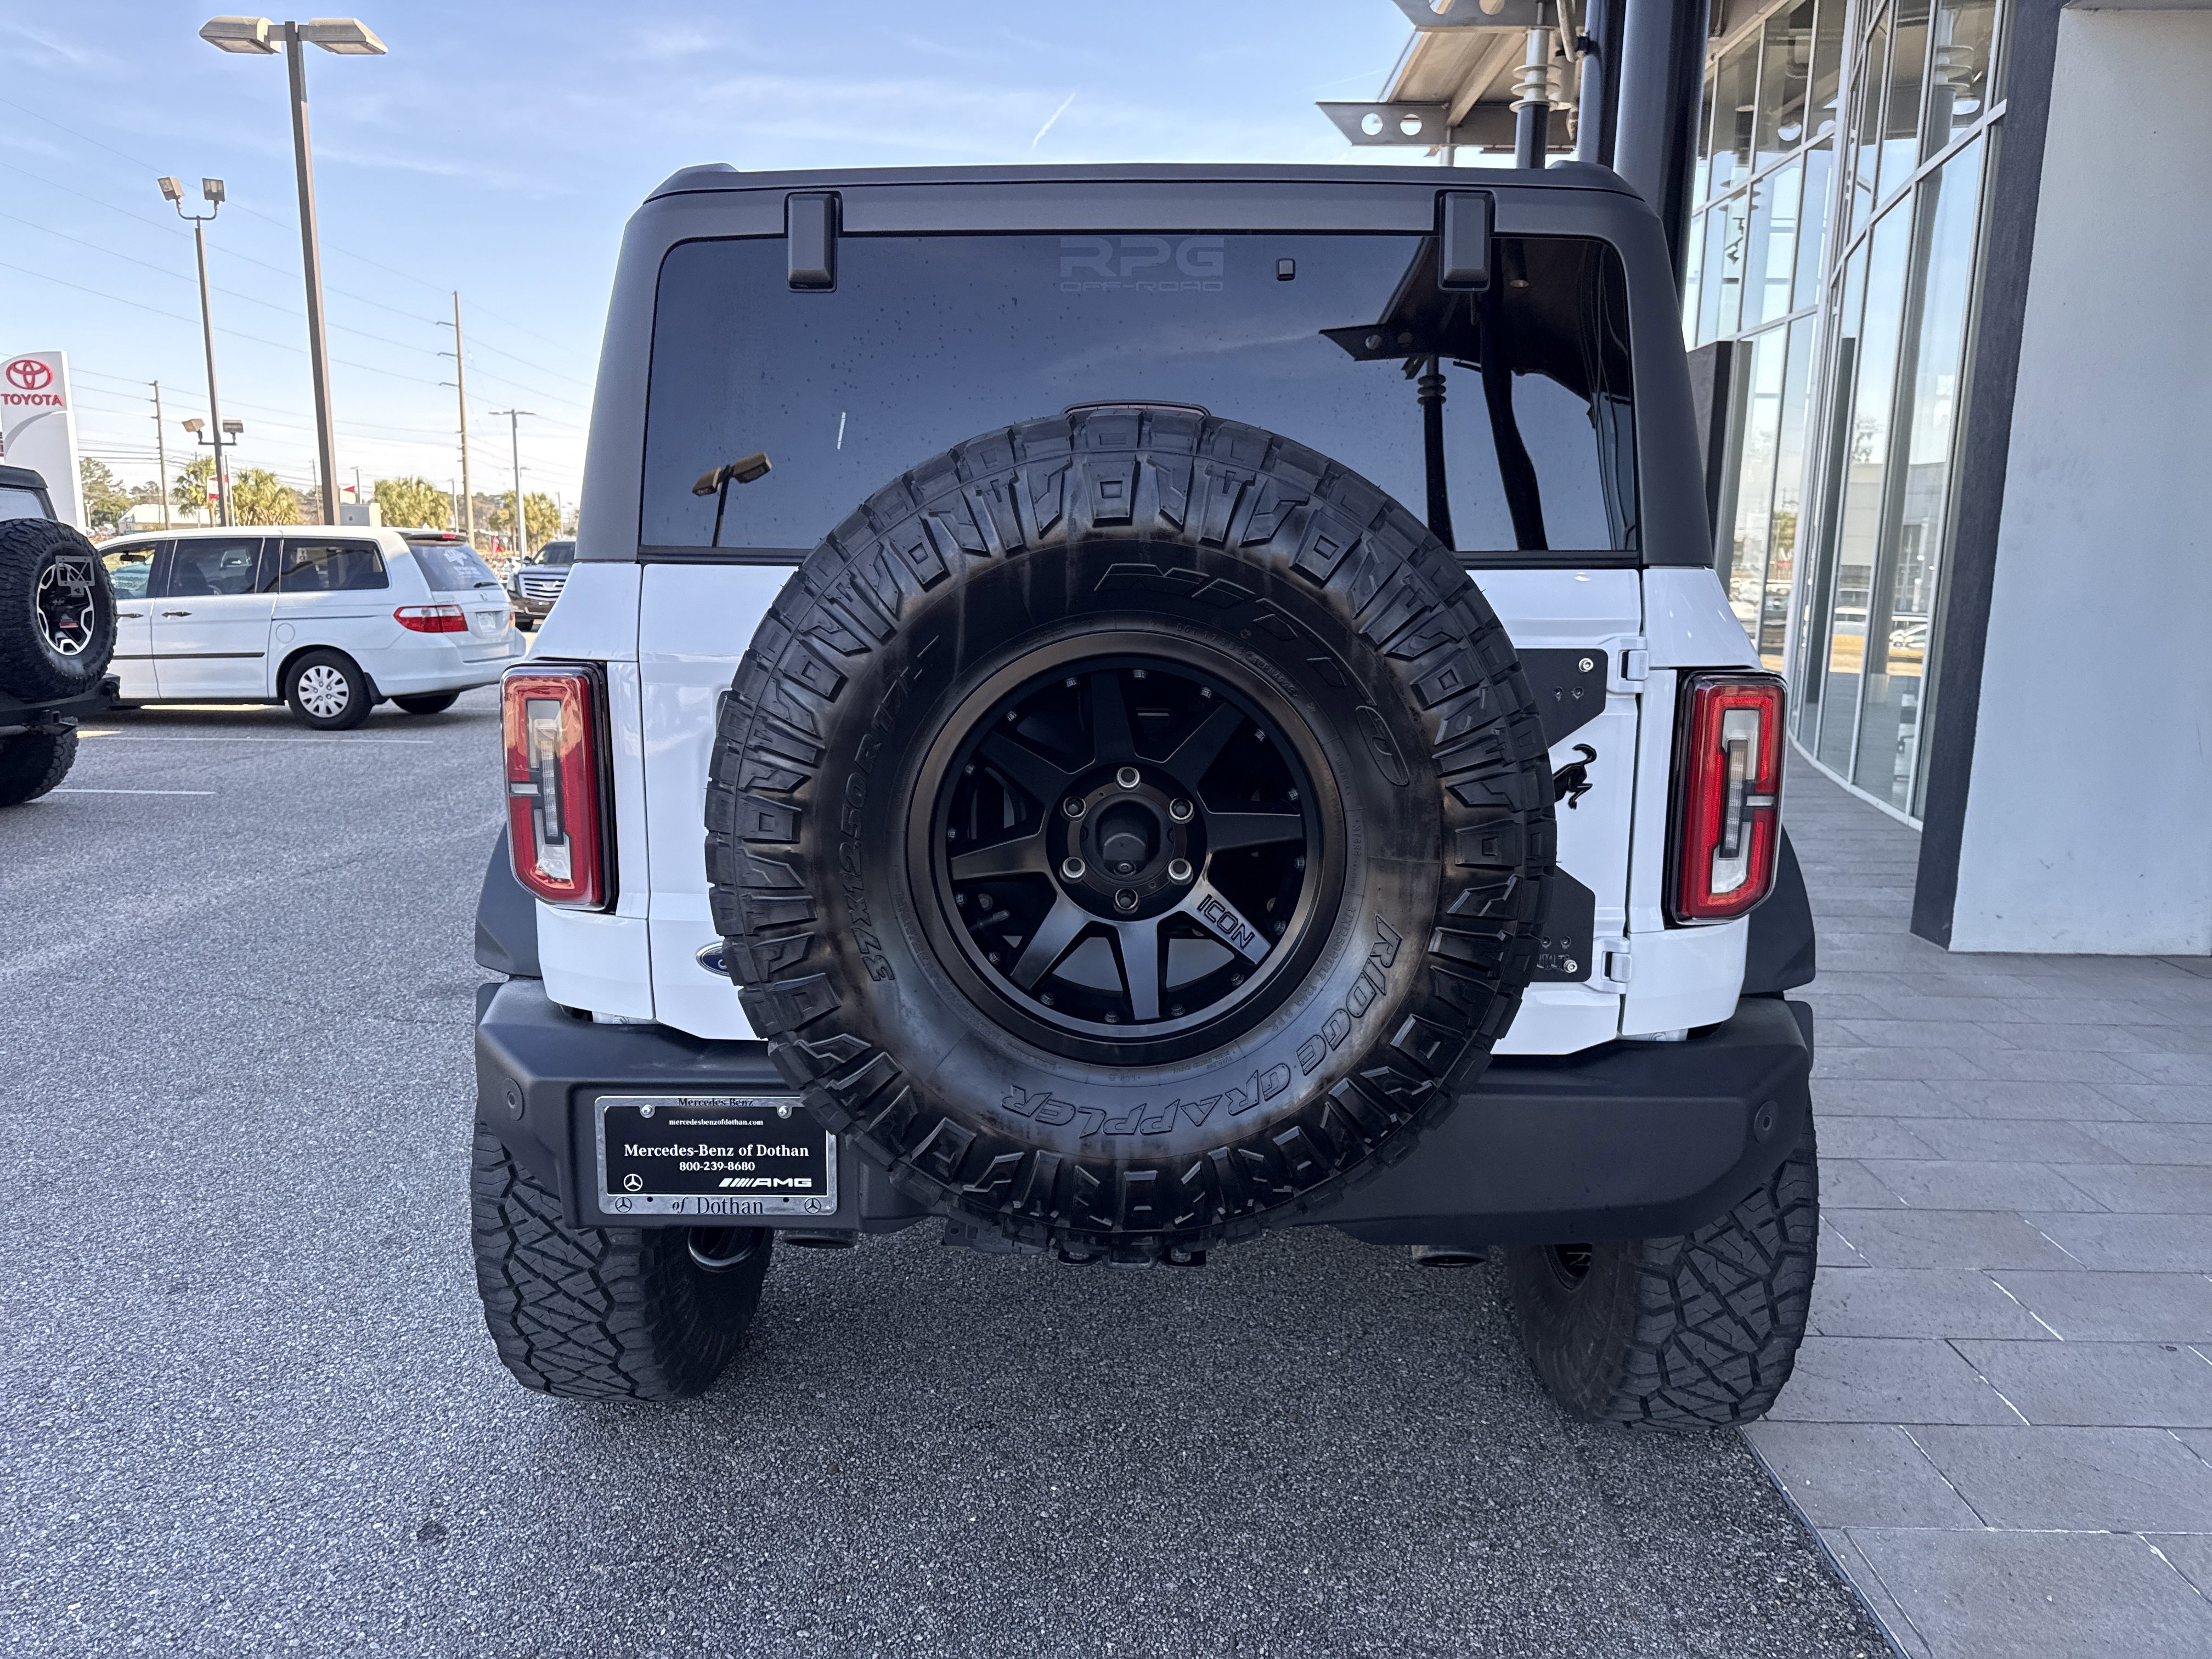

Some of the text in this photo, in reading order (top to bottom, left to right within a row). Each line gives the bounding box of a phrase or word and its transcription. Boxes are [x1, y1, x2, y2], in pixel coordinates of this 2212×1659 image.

[1060, 237, 1224, 277] RPG
[1060, 281, 1223, 292] OFF-ROAD
[0, 393, 64, 407] TOYOTA
[1197, 894, 1255, 950] ICON
[1001, 913, 1403, 1139] RIDGE GRAPPLER
[678, 1098, 754, 1107] Mercedes-Benz
[624, 1144, 809, 1156] Mercedes-Benz of Dothan
[679, 1161, 755, 1171] 800-239-8680
[752, 1178, 812, 1188] AMG
[672, 1197, 763, 1214] of Dothan
